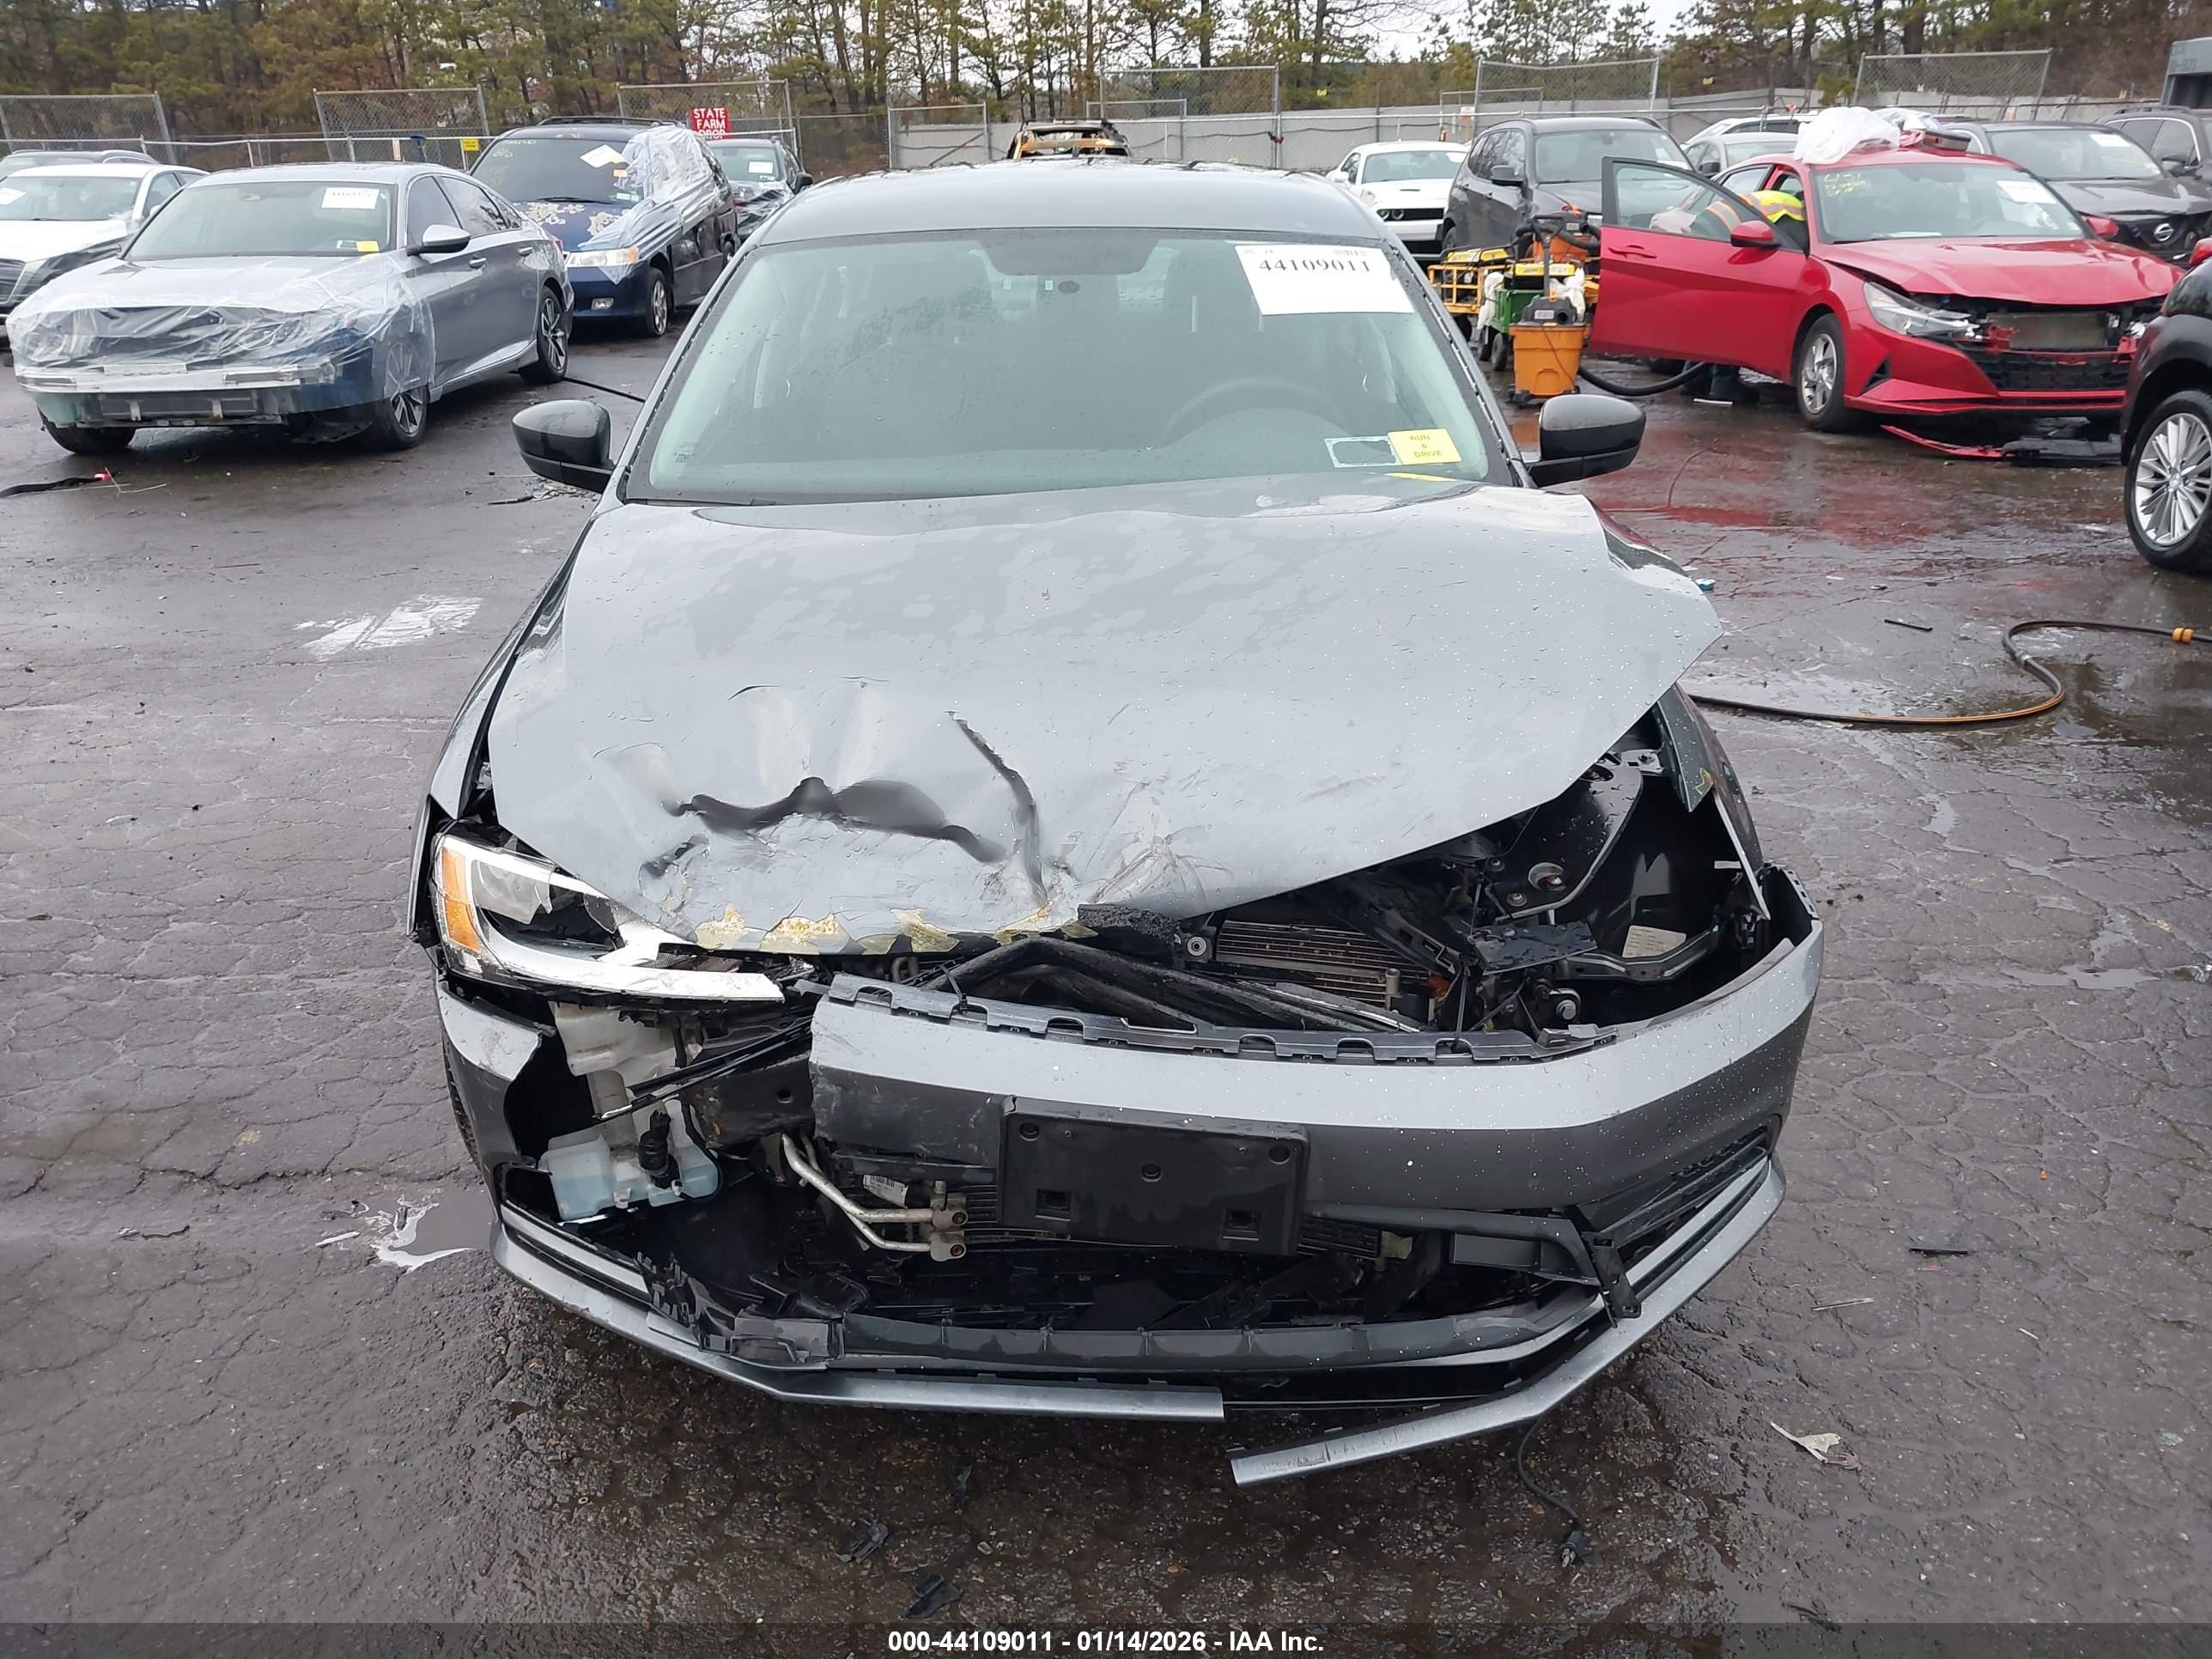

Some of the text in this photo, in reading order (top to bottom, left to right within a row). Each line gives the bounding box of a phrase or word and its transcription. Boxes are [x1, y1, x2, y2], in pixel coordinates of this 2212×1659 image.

[693, 107, 726, 118] STATE
[696, 118, 726, 130] FARM
[698, 129, 726, 139] DROP
[1259, 259, 1370, 272] 44109011
